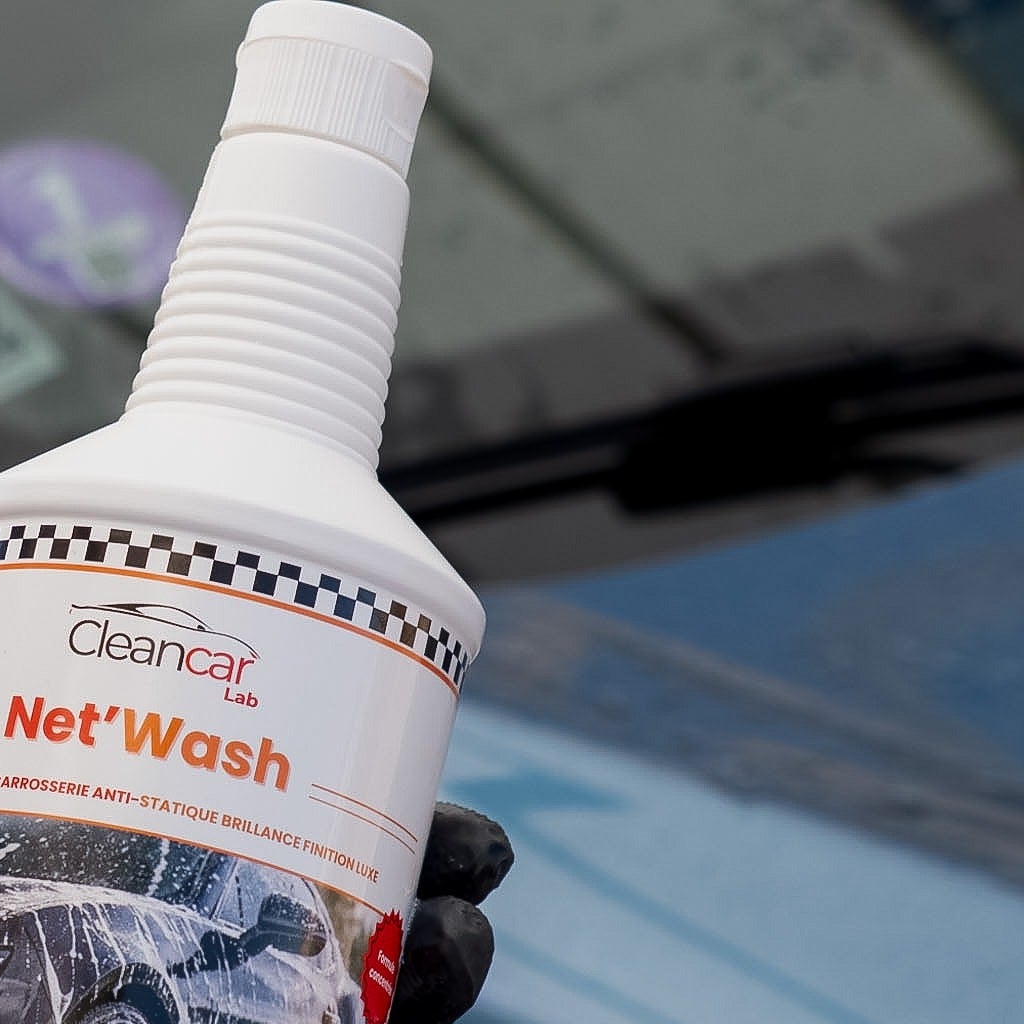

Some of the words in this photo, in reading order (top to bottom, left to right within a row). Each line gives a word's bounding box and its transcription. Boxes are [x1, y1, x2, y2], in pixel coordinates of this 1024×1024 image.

[69, 620, 255, 685] Cleancar
[223, 687, 259, 708] Lab
[92, 786, 219, 825] ANTI-STATIQUE
[221, 813, 302, 850] BRILLANCE
[302, 839, 356, 872] FINITION
[356, 860, 380, 884] LUXE
